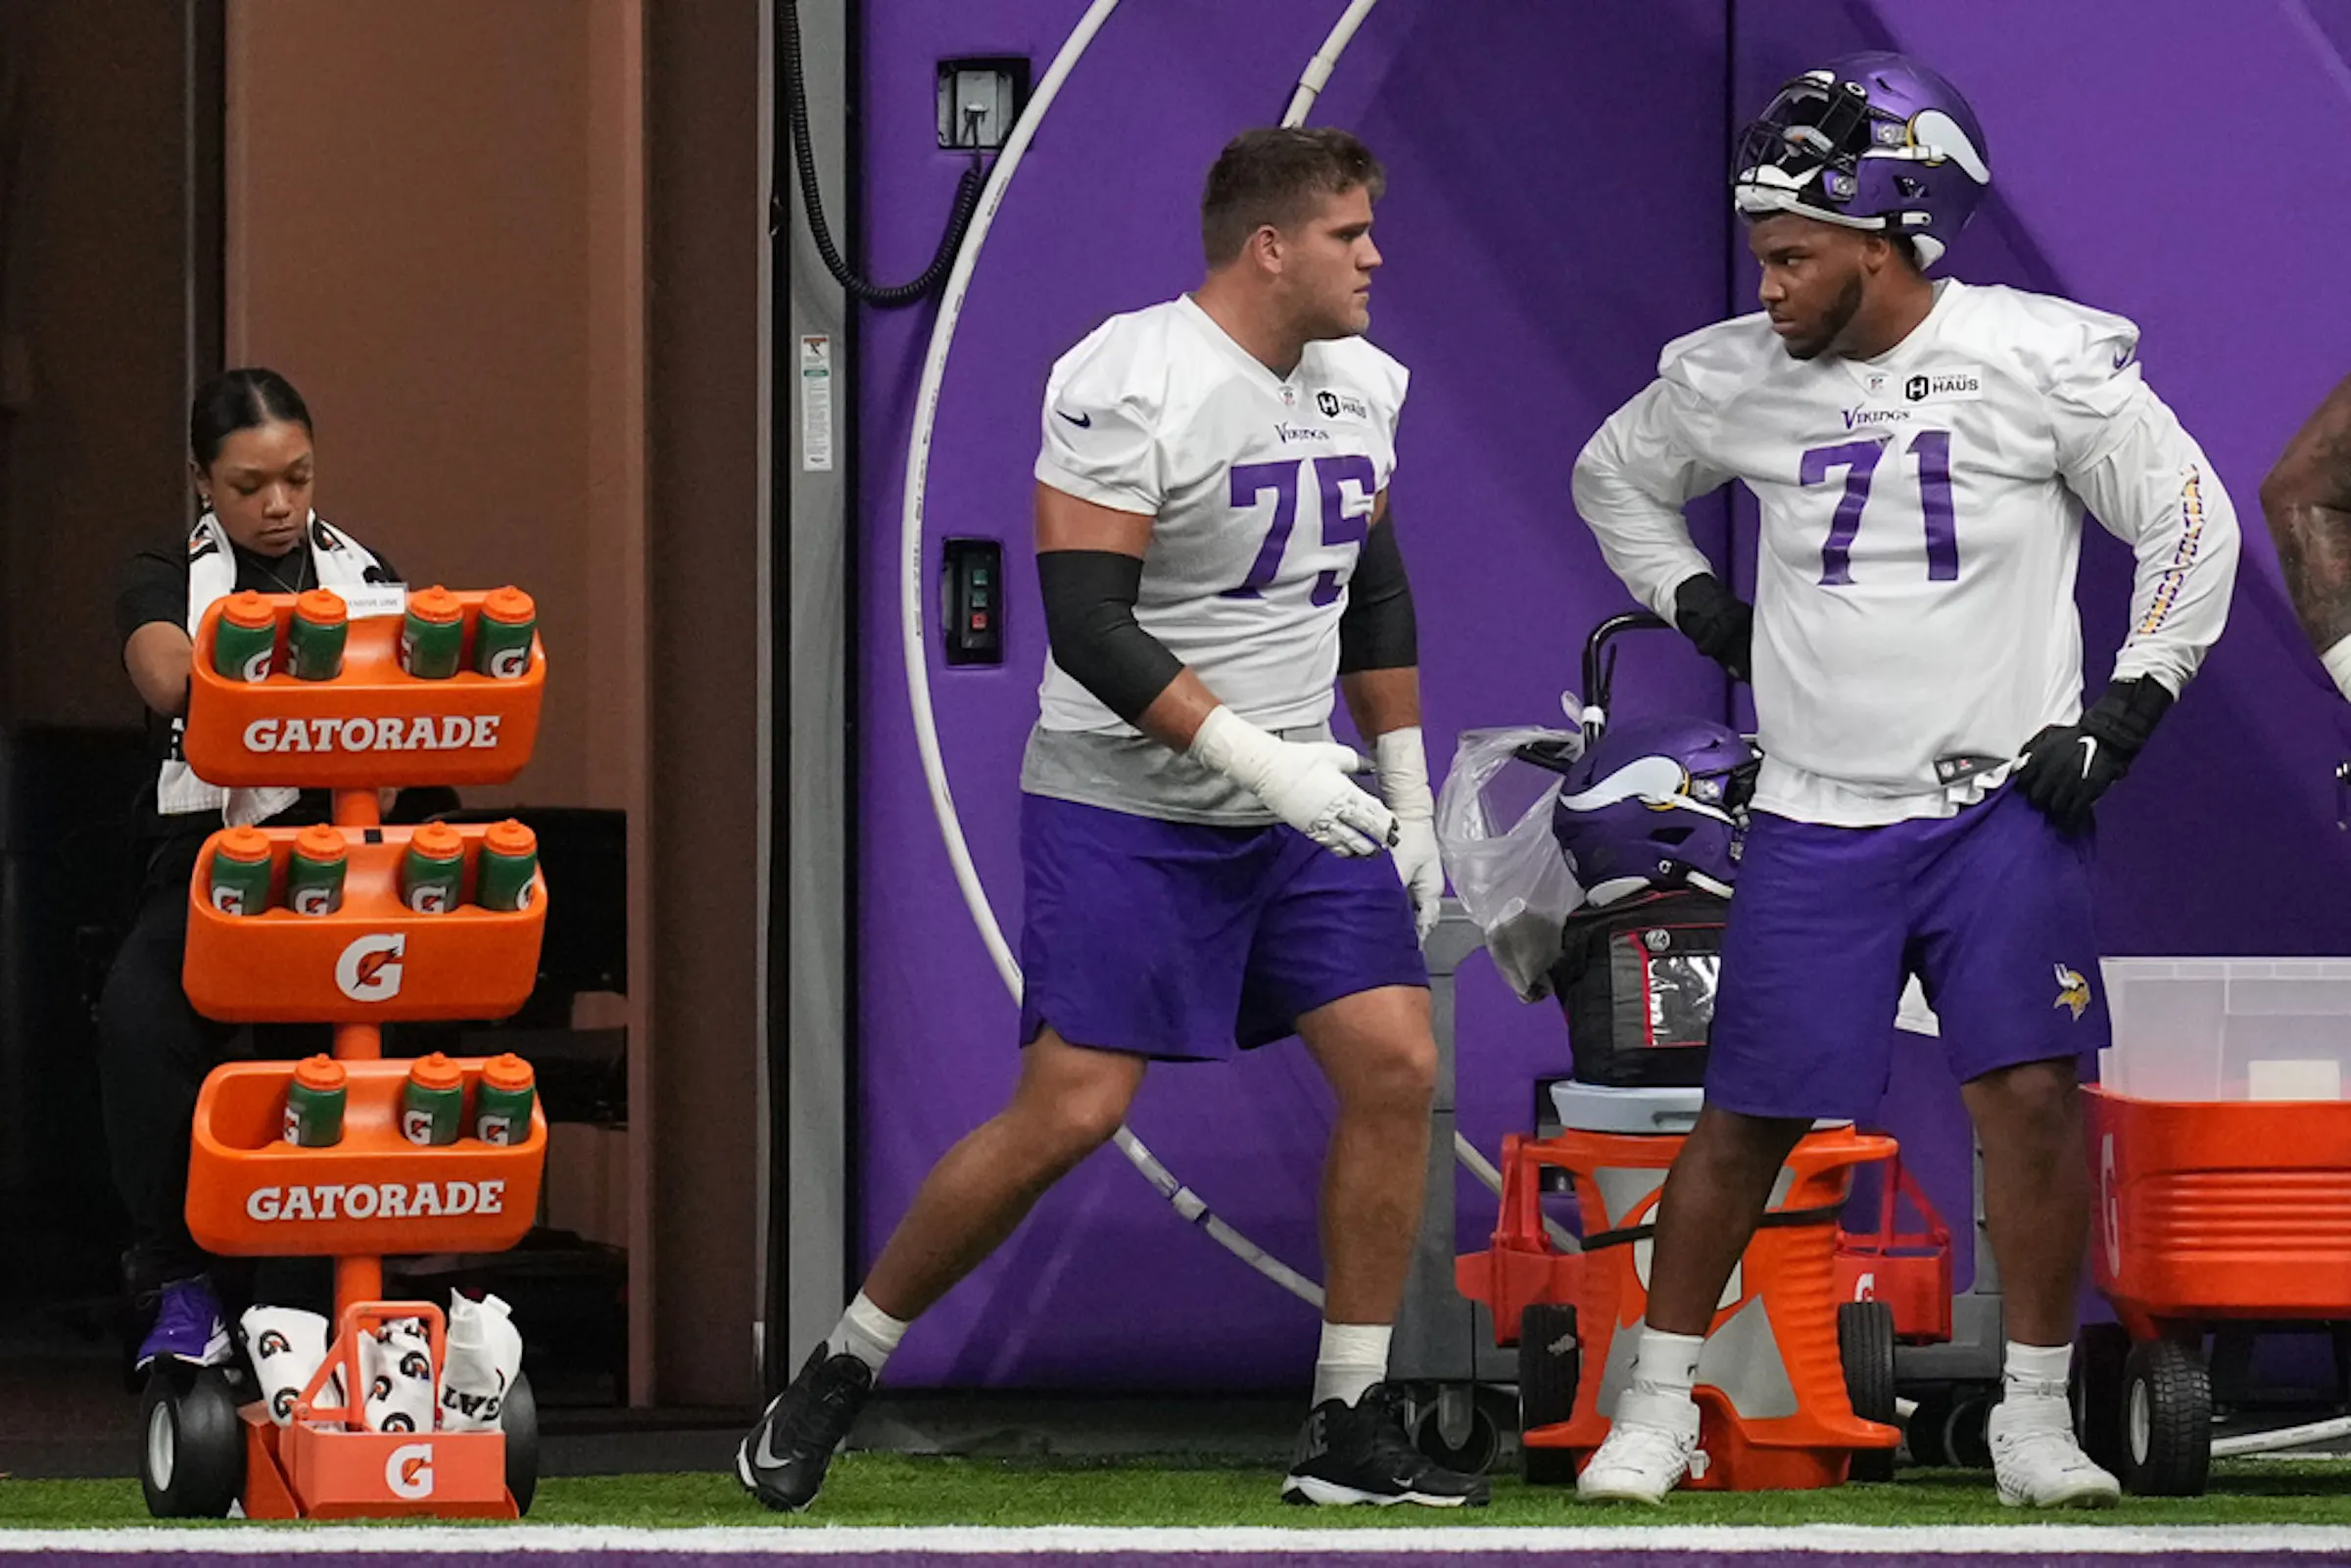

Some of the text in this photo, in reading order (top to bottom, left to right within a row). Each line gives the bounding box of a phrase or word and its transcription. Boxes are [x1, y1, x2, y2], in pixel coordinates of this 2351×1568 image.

[1933, 379, 1979, 393] HAUS
[1799, 430, 1958, 586] 71
[1217, 455, 1375, 607] 75
[491, 646, 526, 679] G
[243, 715, 501, 752] GATORADE
[295, 888, 331, 917] G
[411, 885, 448, 914] G
[335, 932, 406, 1003] G
[404, 1110, 433, 1145] G
[477, 1116, 510, 1146] G
[246, 1180, 504, 1220] GATORADE
[385, 1443, 434, 1500] G
